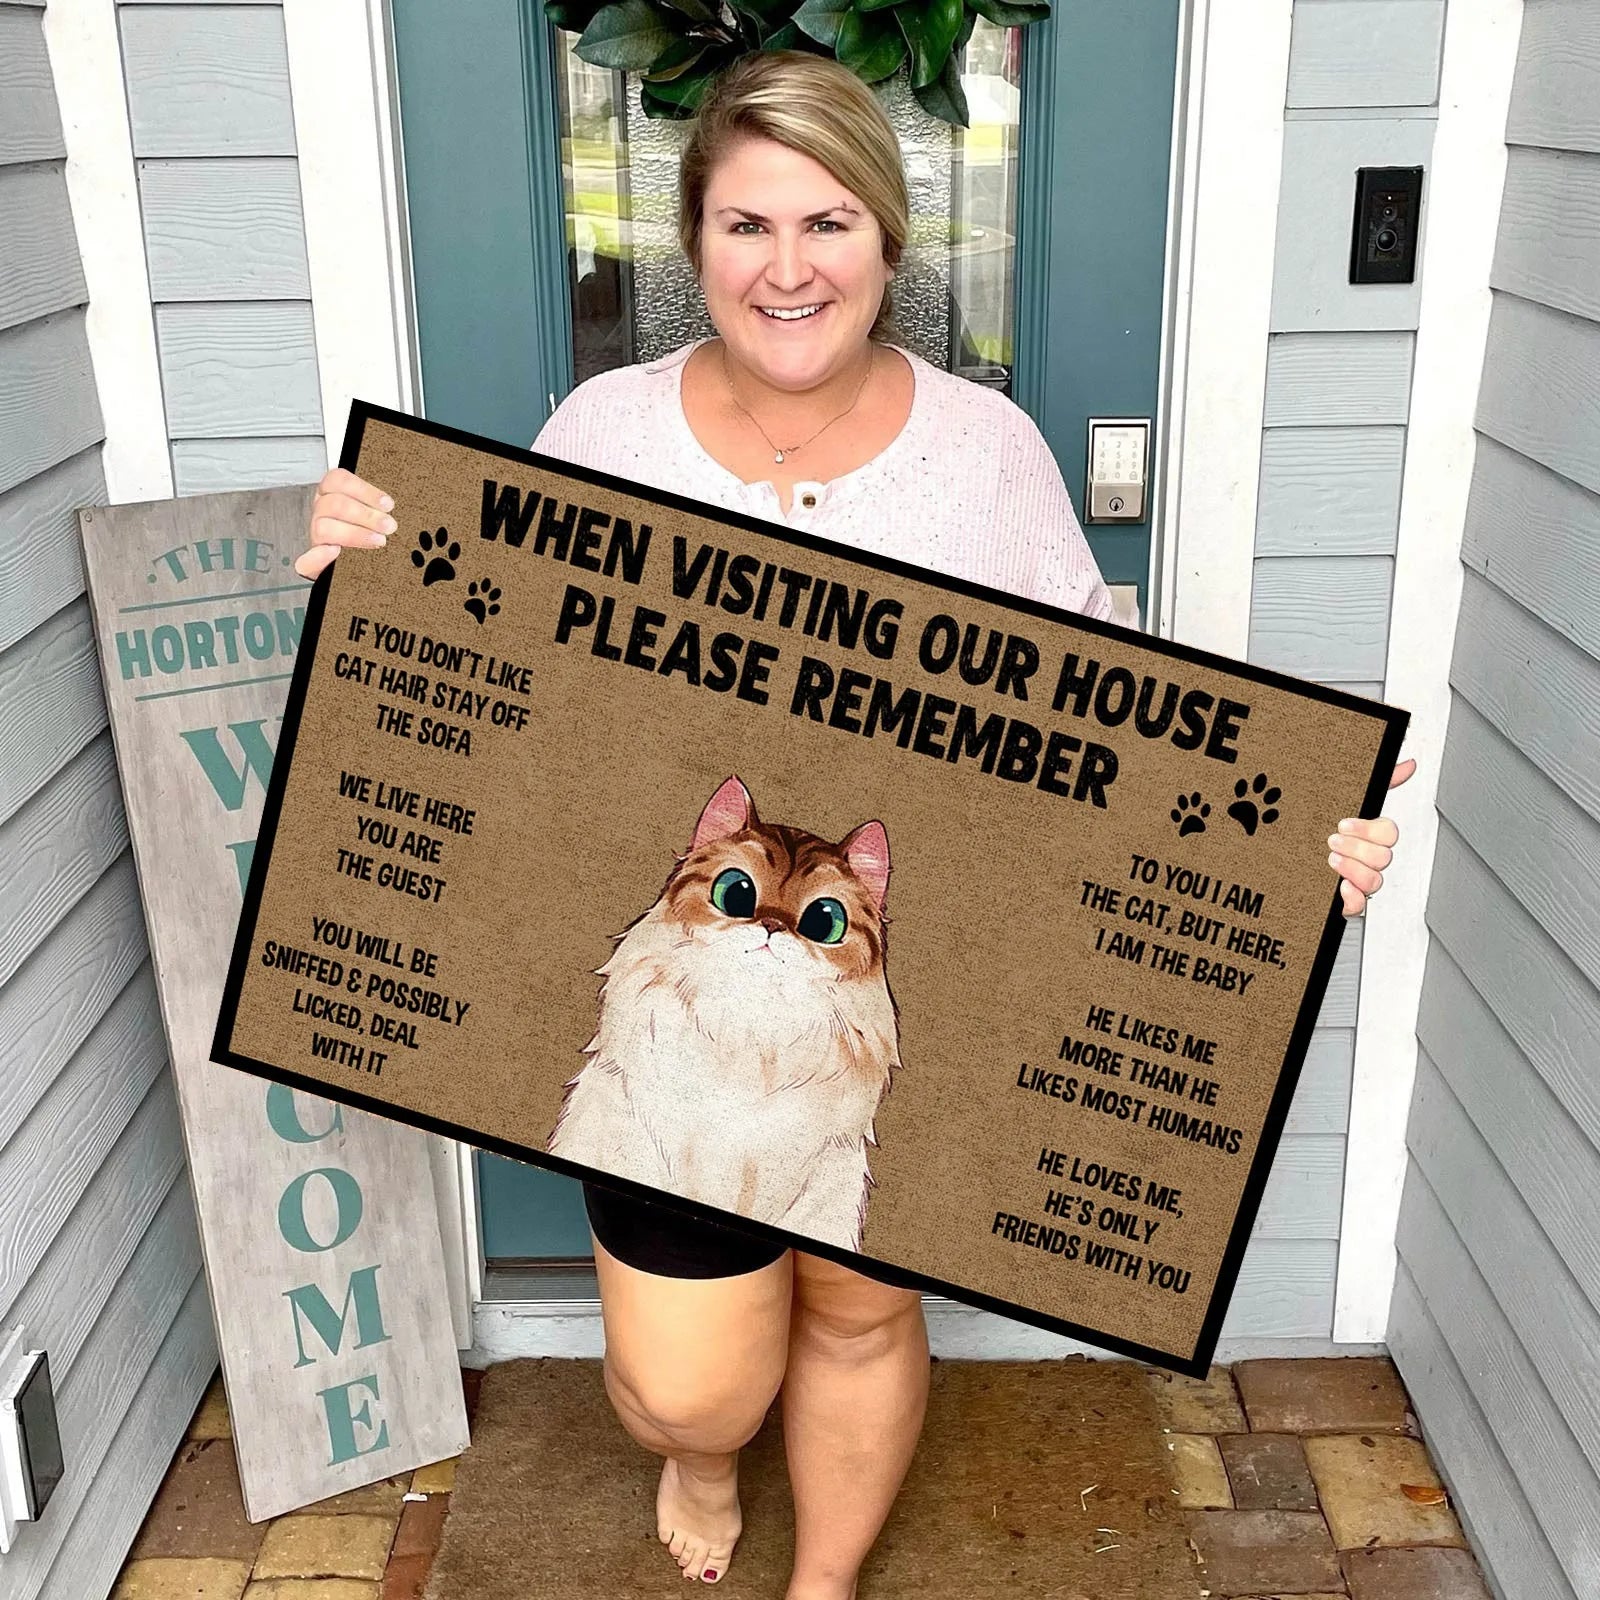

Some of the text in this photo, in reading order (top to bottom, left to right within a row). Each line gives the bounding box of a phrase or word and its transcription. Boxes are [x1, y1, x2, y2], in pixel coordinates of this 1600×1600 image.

[347, 615, 534, 696] IF YOU DON'T LIKE
[479, 478, 1251, 765] WHEN VISITING OUR HOUSE
[334, 652, 531, 732] CAT HAIR STAY OFF
[553, 583, 1120, 810] PLEASE REMEMBER
[376, 703, 471, 757] THE SOFA
[338, 770, 477, 836] WE LIVE HERE
[357, 815, 444, 865] YOU ARE
[336, 848, 447, 904] THE GUEST
[1129, 853, 1266, 919] TO YOU I AM
[312, 916, 439, 979] YOU WILL BE
[1080, 880, 1287, 971] THE CAT, BUT HERE,
[261, 940, 471, 1027] SNIFFED & POSSIBLY
[1094, 927, 1255, 996] I AM THE BABY
[292, 988, 420, 1050] LICKED, DEAL
[311, 1031, 388, 1076] WITH IT
[1085, 1004, 1219, 1066] HE LIKES ME
[1057, 1035, 1221, 1108] MORE THAN HE
[1016, 1062, 1243, 1155] LIKES MOST HUMANS
[1036, 1147, 1184, 1220] HE LOVES ME,
[1043, 1188, 1161, 1245] HE'S ONLY
[991, 1211, 1192, 1295] FRIENDS WITH YOU
